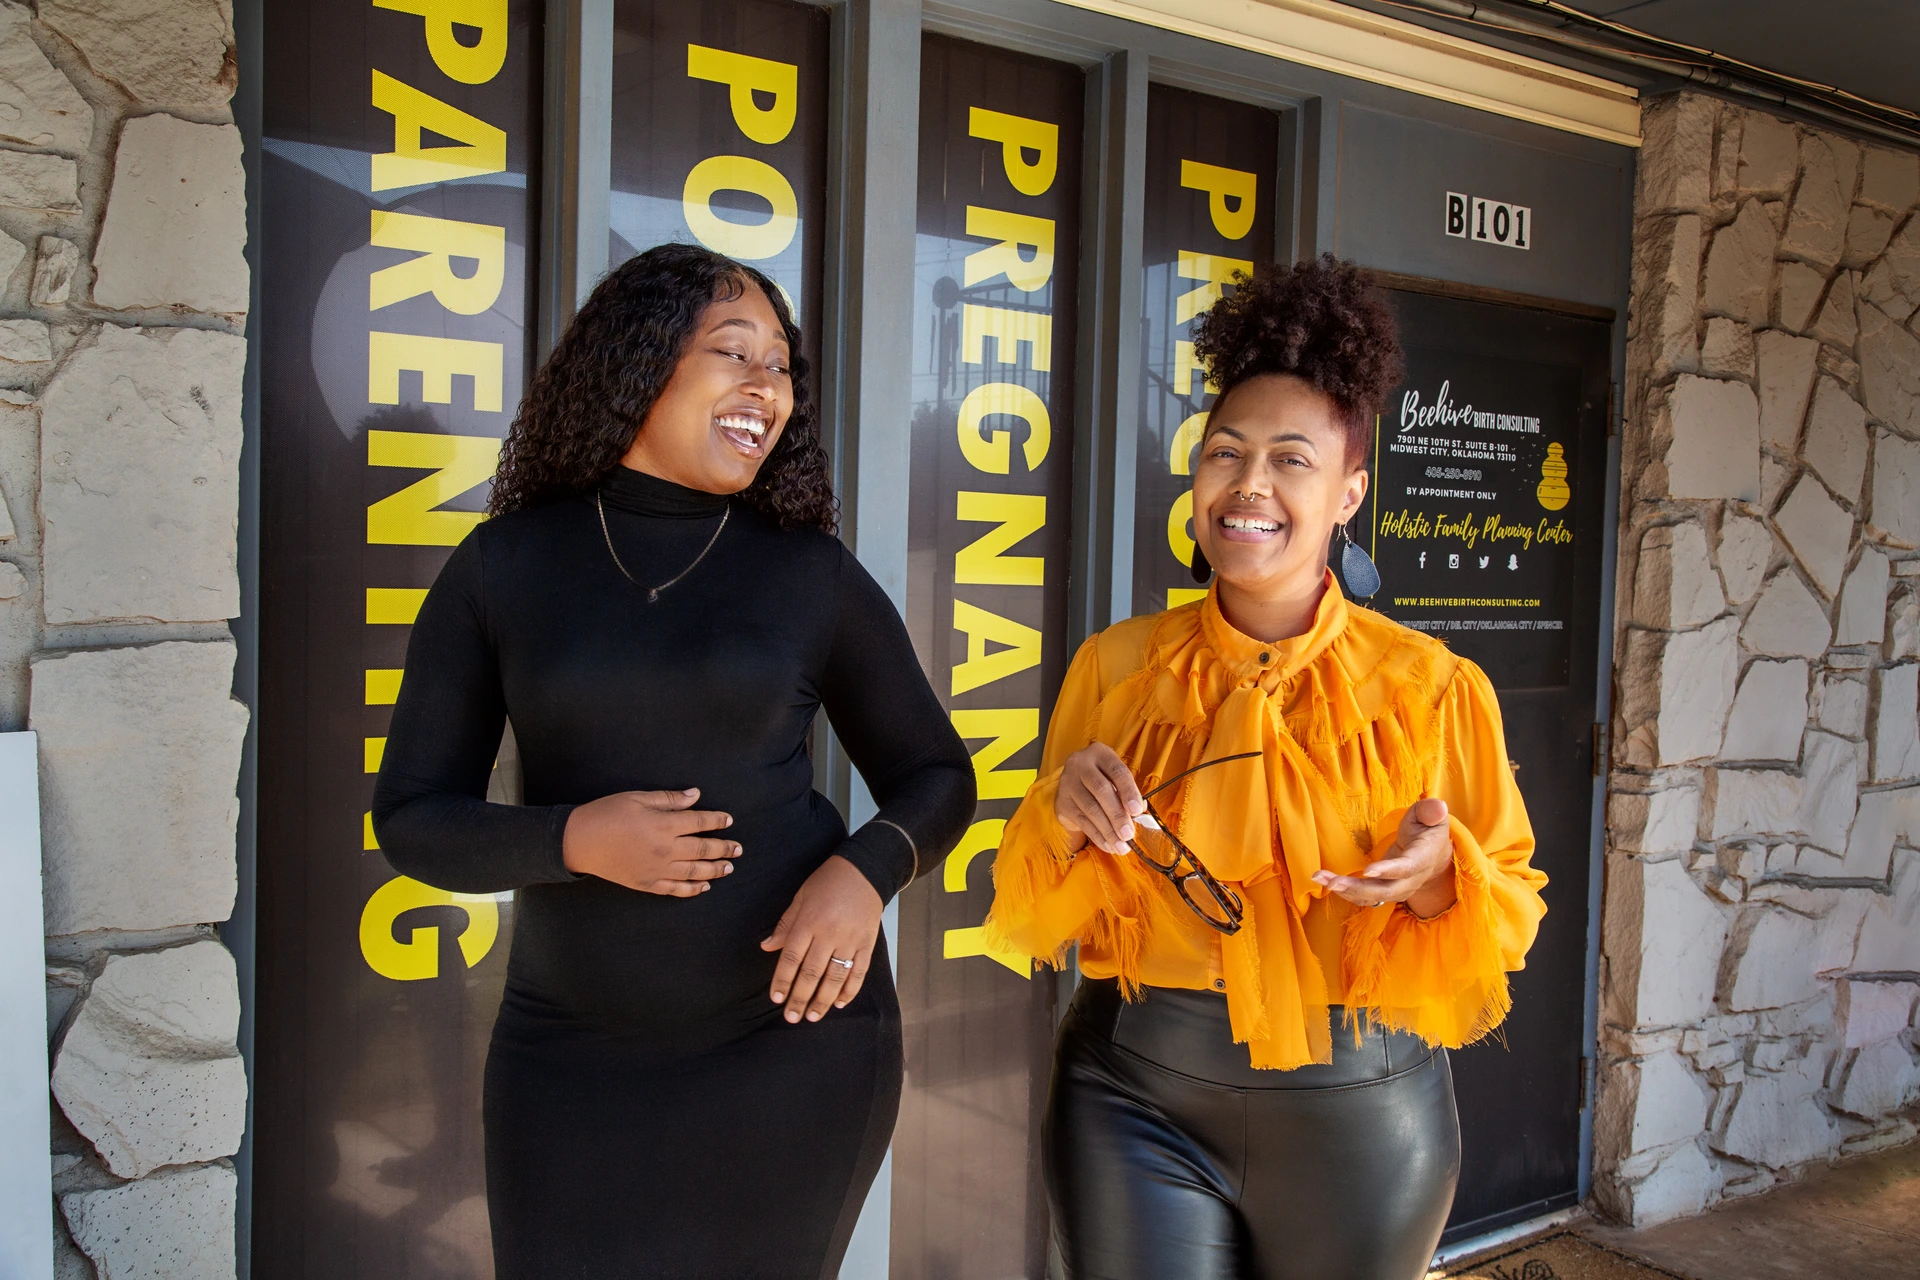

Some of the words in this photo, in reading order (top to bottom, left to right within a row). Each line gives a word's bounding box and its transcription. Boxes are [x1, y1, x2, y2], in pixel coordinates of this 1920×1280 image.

[683, 43, 799, 324] PO
[1448, 194, 1464, 234] B
[1476, 201, 1525, 247] 101
[1400, 380, 1475, 432] Beehive
[1473, 411, 1496, 429] BIRTH
[1496, 413, 1541, 434] CONSULTING
[1390, 443, 1428, 455] MIDWEST
[1429, 446, 1450, 457] CITY,
[1451, 449, 1495, 461] OKLAHOMA
[1496, 452, 1517, 462] 73110
[1397, 435, 1416, 444] 7901
[1417, 437, 1429, 446] NE
[1430, 437, 1450, 448] 10TH
[1451, 440, 1464, 449] ST.
[1465, 441, 1488, 451] SUITE
[1489, 443, 1509, 452] B-101
[359, 0, 509, 981] PARENG
[1406, 486, 1418, 496] BY
[1418, 487, 1475, 499] APPOINTMENT
[1476, 491, 1497, 501] ONLY
[1380, 509, 1432, 540] Holistic
[1433, 512, 1480, 550] Family
[1482, 513, 1535, 550] Planning
[1536, 517, 1574, 545] Center
[1394, 597, 1541, 608] WWW.BEEHIVEBIRTHCONSULTING.COM
